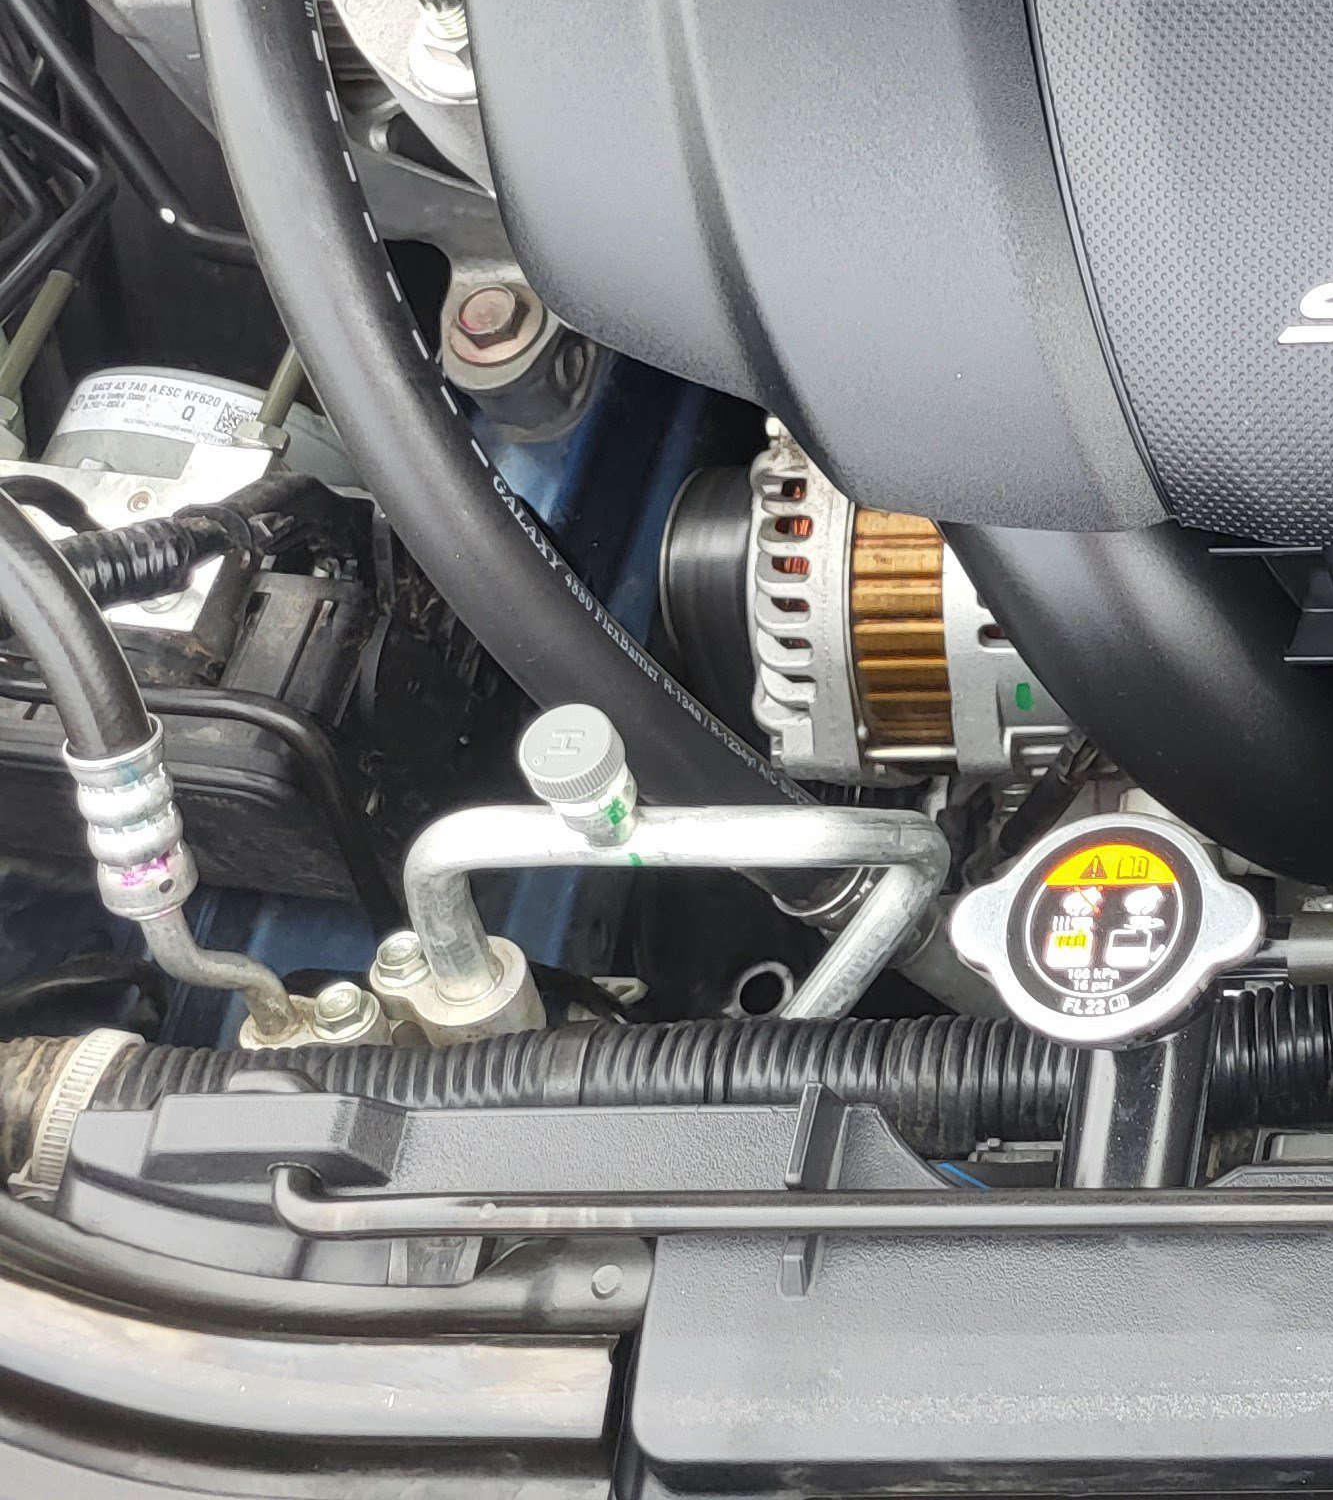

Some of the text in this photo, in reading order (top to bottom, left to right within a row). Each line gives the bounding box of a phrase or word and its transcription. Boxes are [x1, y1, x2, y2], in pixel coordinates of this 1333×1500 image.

[158, 386, 181, 398] ESC
[184, 389, 222, 408] KF620
[181, 405, 196, 422] Q
[493, 475, 564, 570] GALAXY
[564, 573, 594, 611] 4880
[546, 729, 585, 755] H
[1092, 967, 1120, 980] kPa
[1073, 978, 1114, 992] 16 psi
[1061, 996, 1106, 1015] FL22
